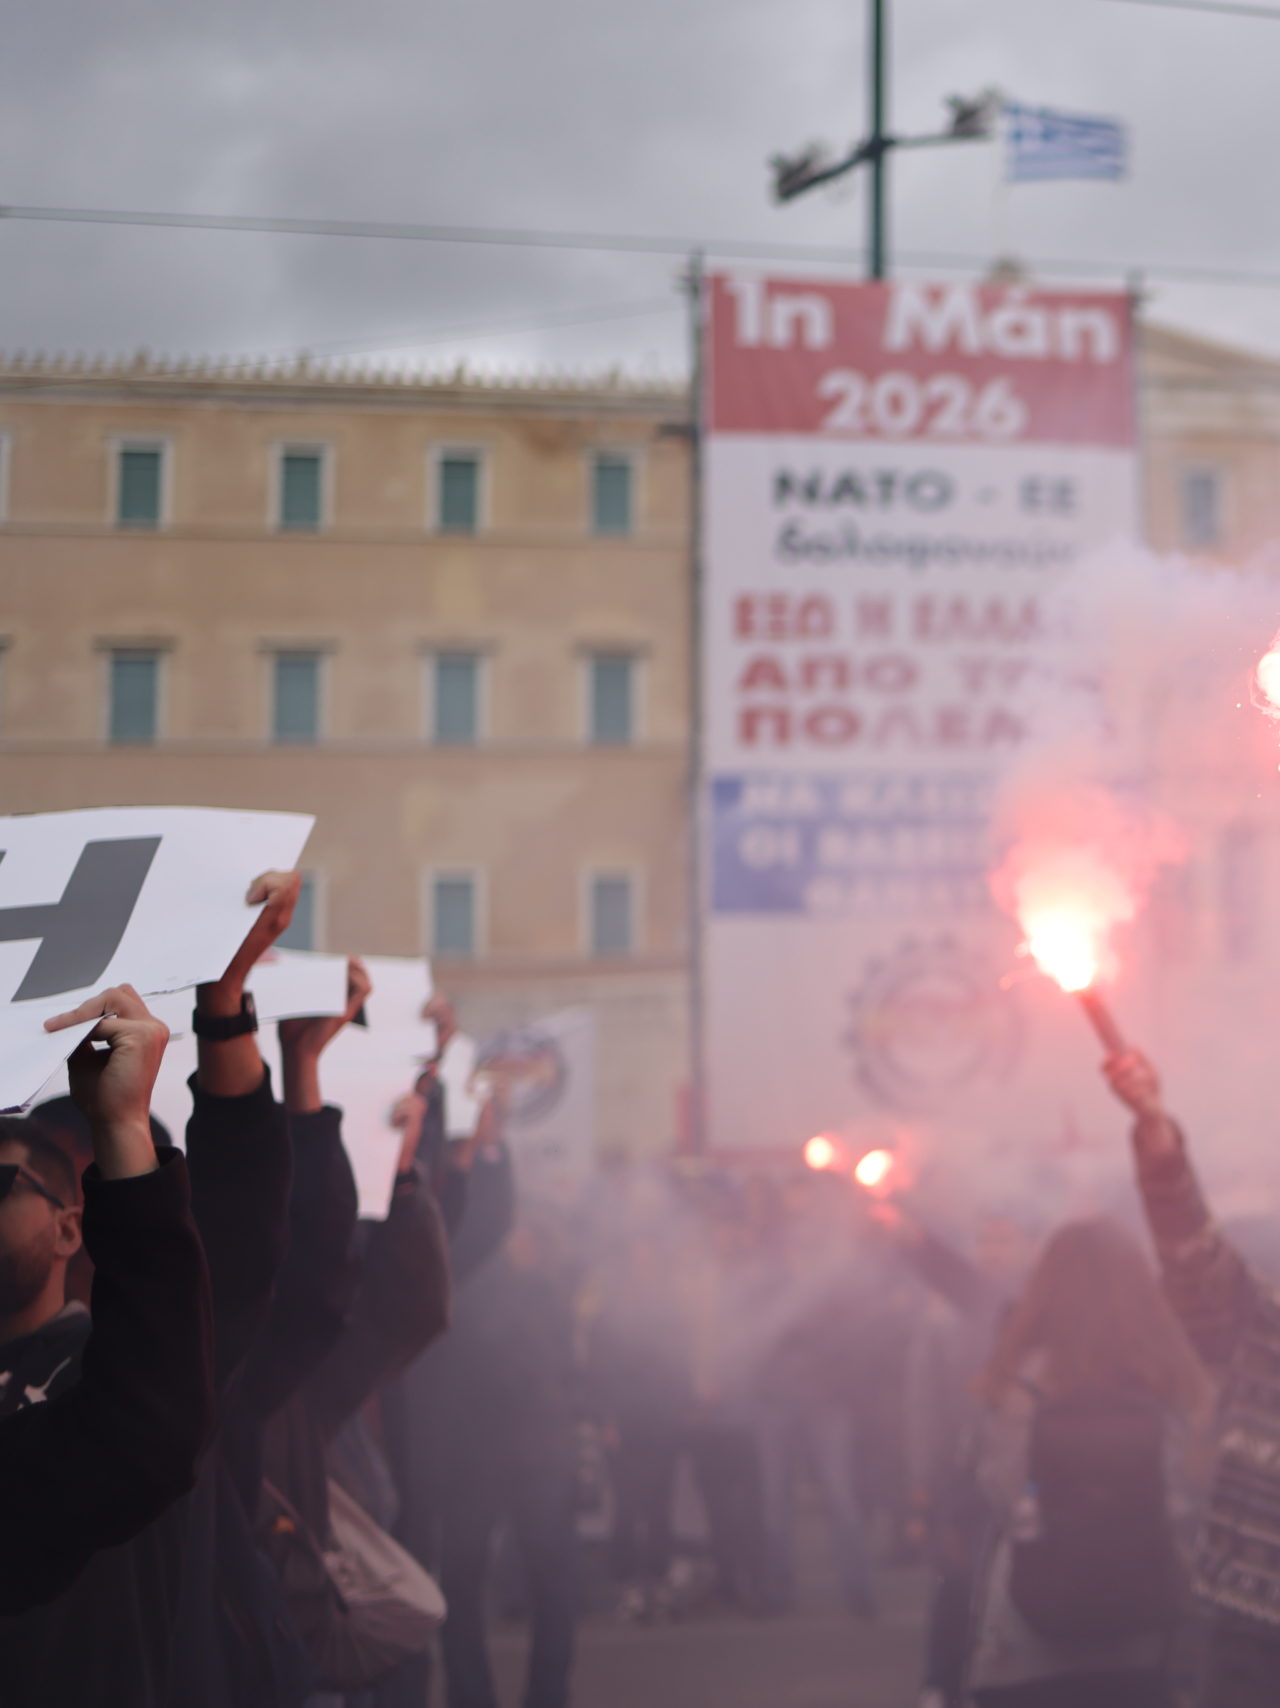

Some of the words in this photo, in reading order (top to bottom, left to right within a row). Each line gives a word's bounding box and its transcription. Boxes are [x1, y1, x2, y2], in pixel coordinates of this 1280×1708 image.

[818, 370, 1027, 439] 2026
[773, 470, 955, 510] ΝΑΤΟ
[1020, 478, 1080, 514] ΕΕ
[735, 594, 835, 640] ΕΞΩ
[736, 654, 920, 694] ΑΠΟ
